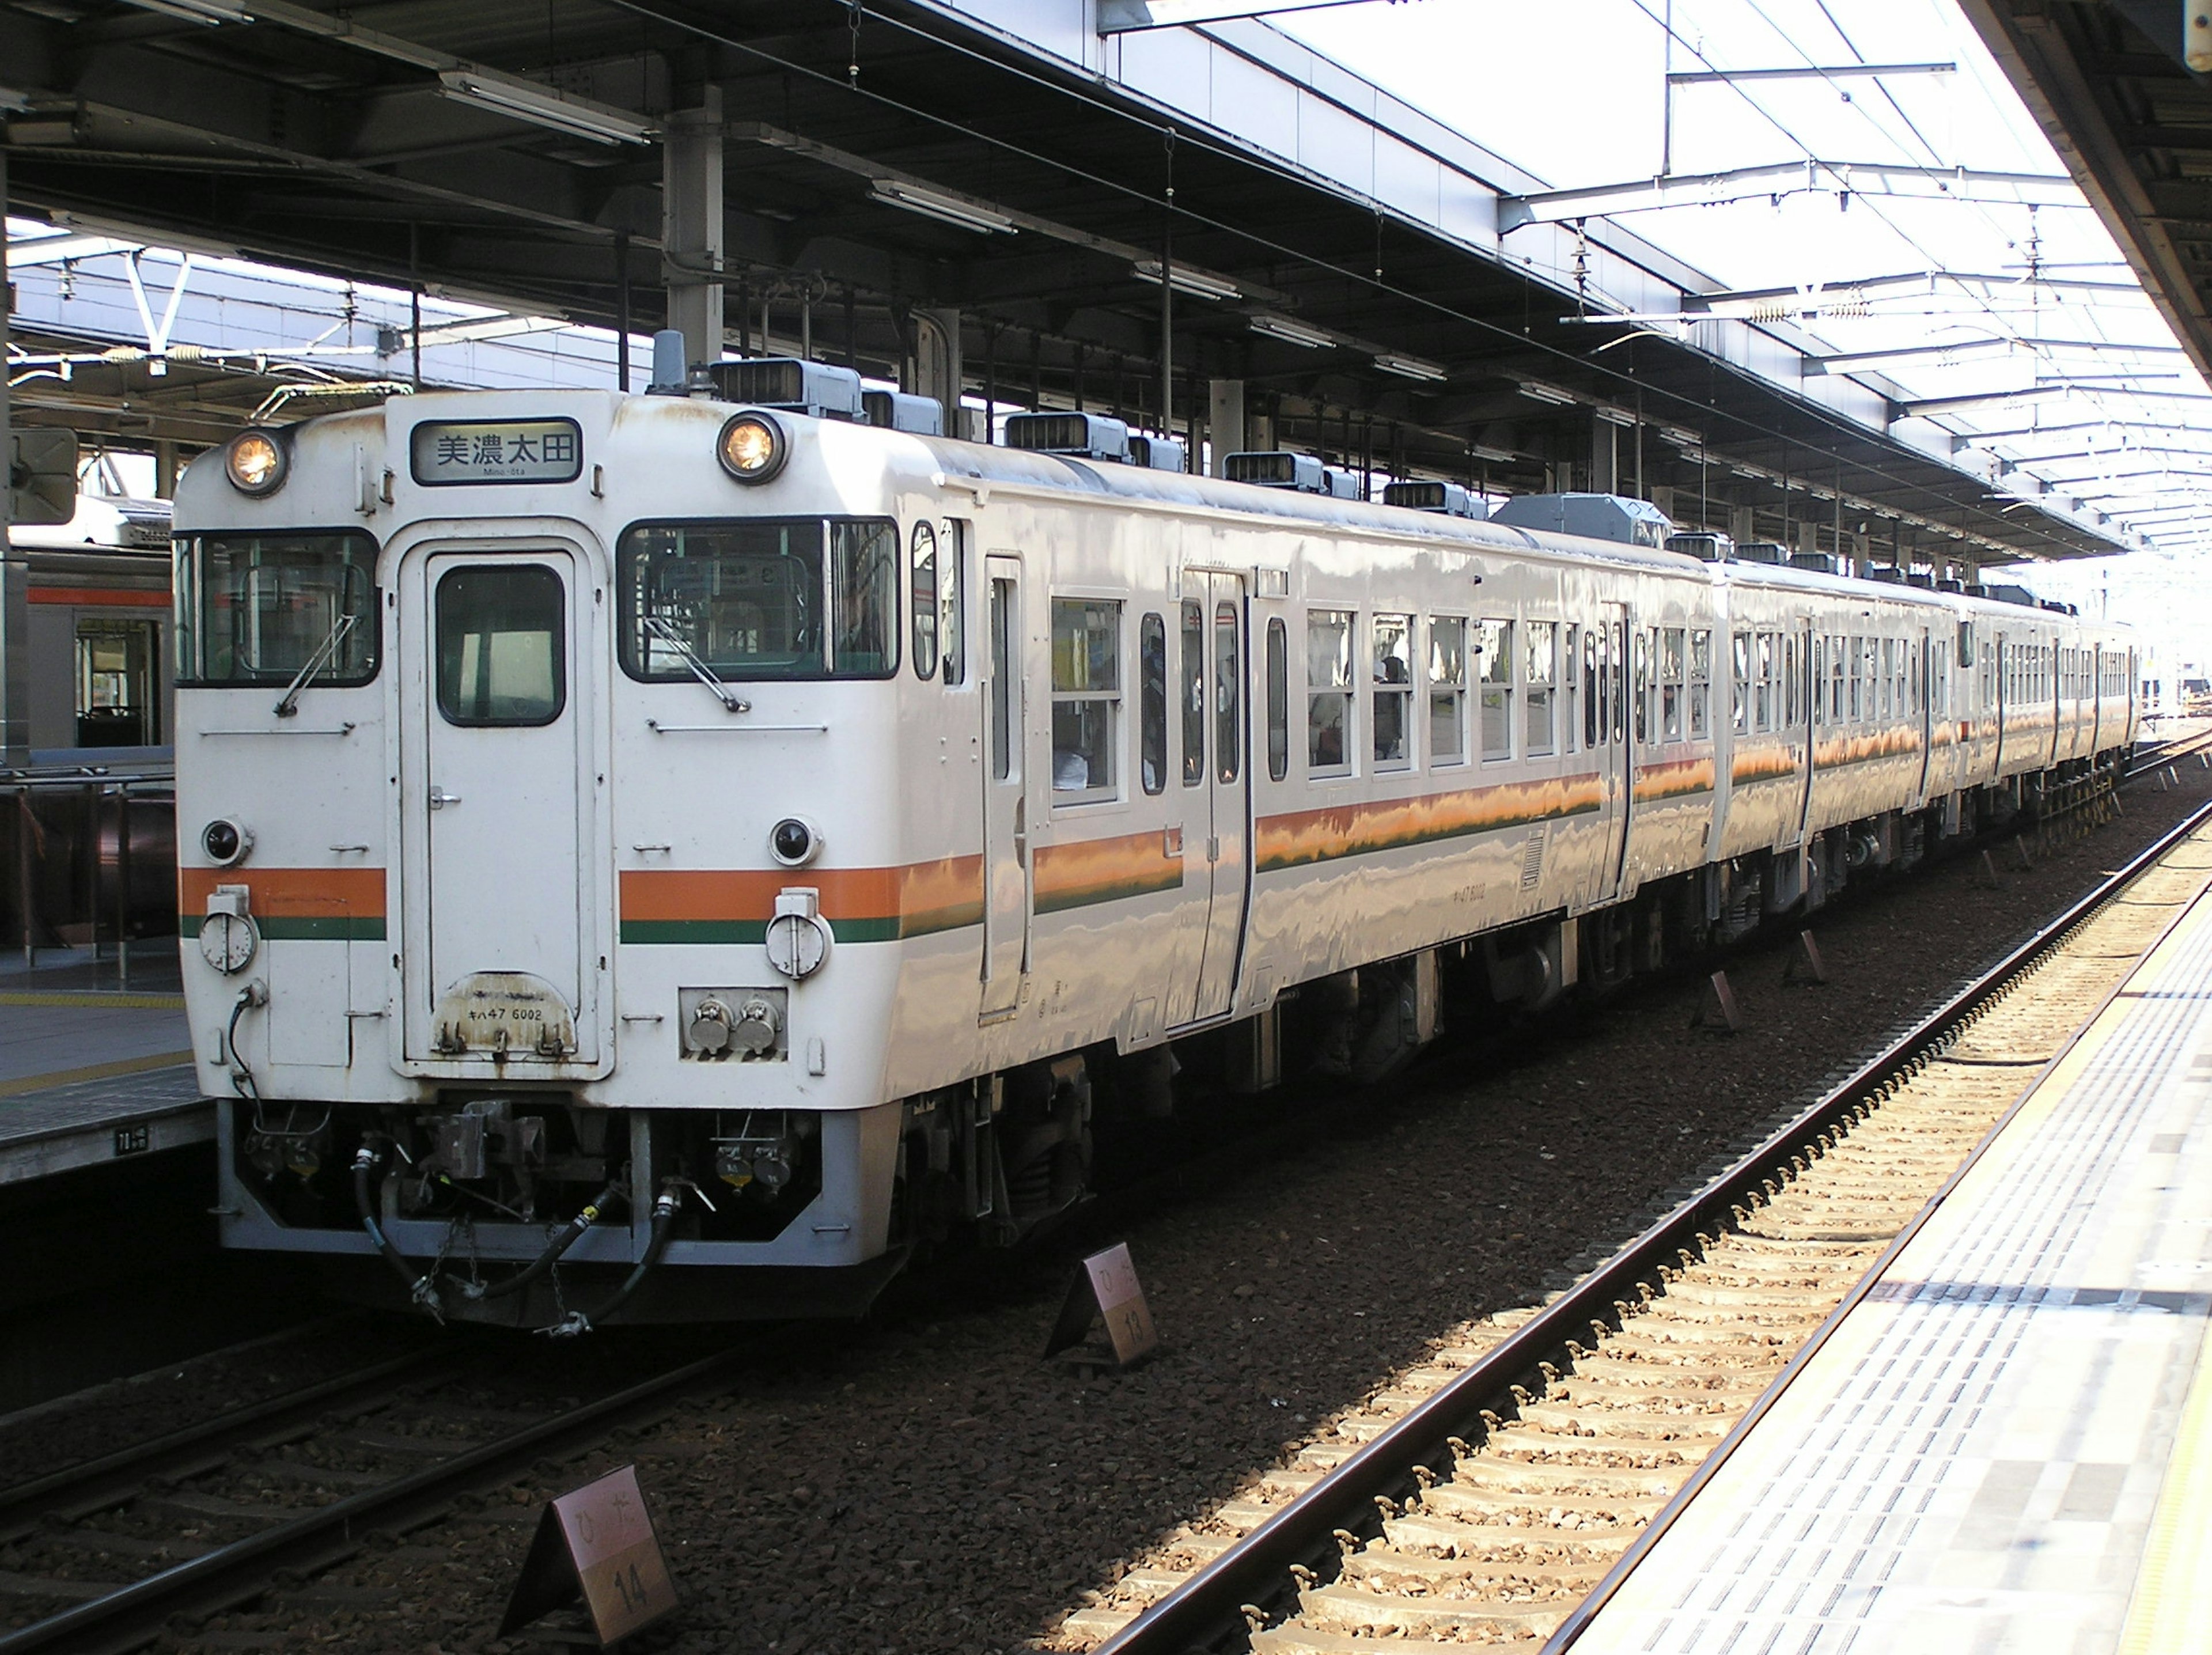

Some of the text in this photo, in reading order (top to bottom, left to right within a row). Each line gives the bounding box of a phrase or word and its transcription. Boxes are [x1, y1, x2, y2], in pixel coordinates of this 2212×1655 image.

[437, 434, 573, 465] 美濃太田
[467, 1008, 543, 1021] キハ47 6002
[1124, 1311, 1143, 1345] 13
[613, 1563, 647, 1614] 14
